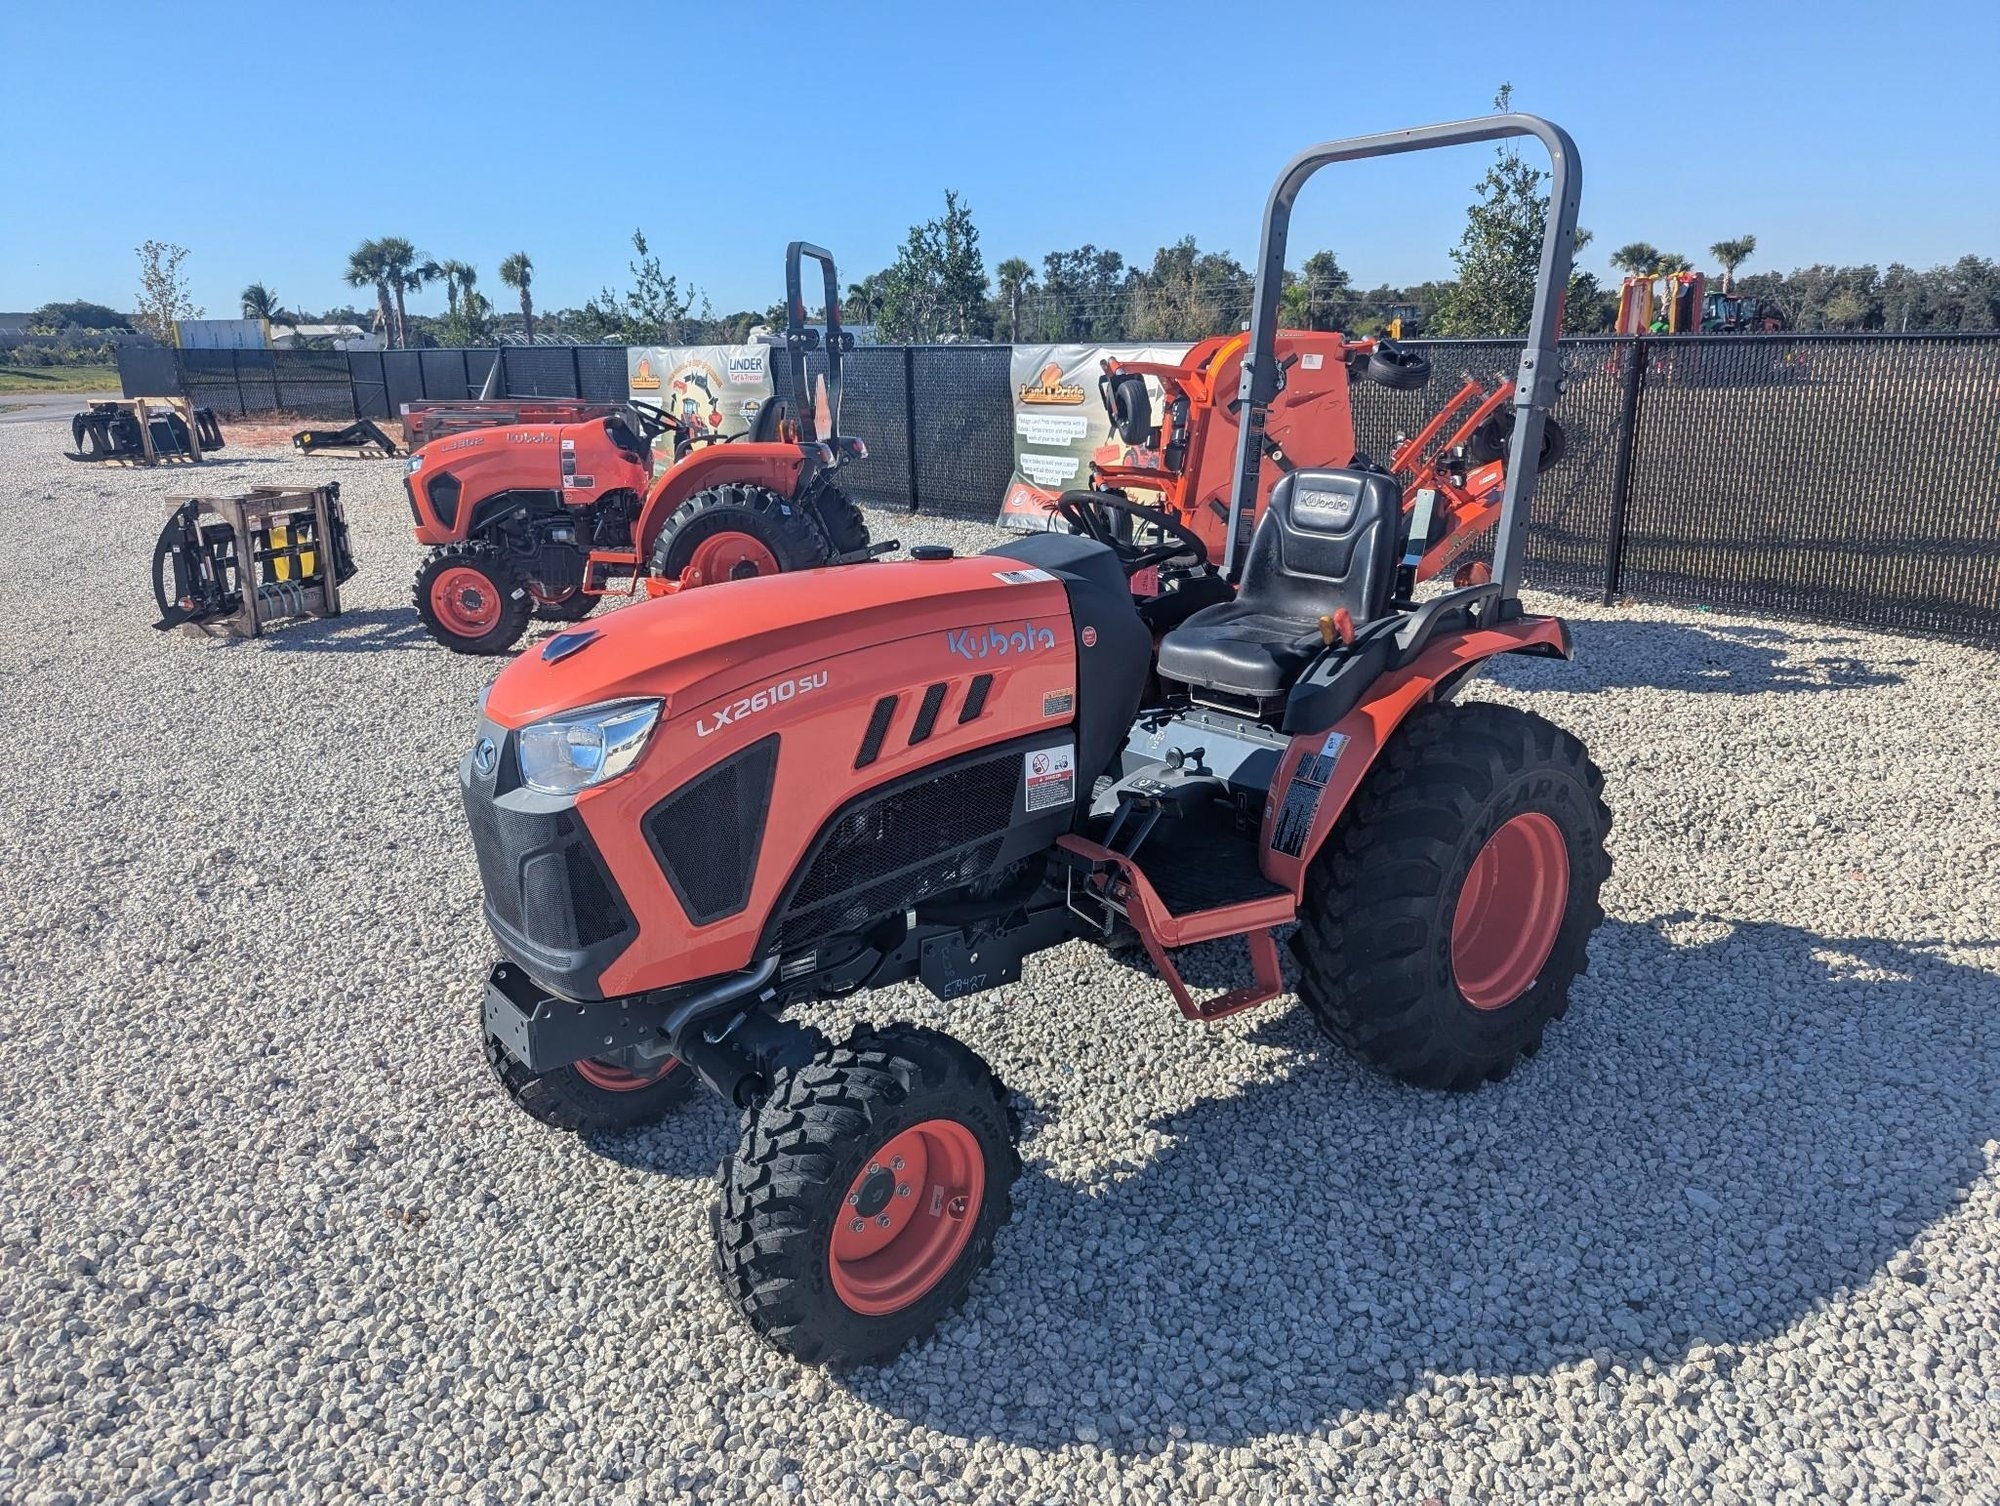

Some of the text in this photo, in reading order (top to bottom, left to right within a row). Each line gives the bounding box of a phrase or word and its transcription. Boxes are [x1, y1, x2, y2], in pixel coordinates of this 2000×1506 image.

[729, 357, 763, 371] LINDER
[1054, 384, 1084, 399] Pride
[505, 431, 555, 444] Kubota
[1300, 491, 1349, 511] Kubota
[948, 622, 1056, 660] Kubota
[696, 671, 828, 737] LX2610 SU
